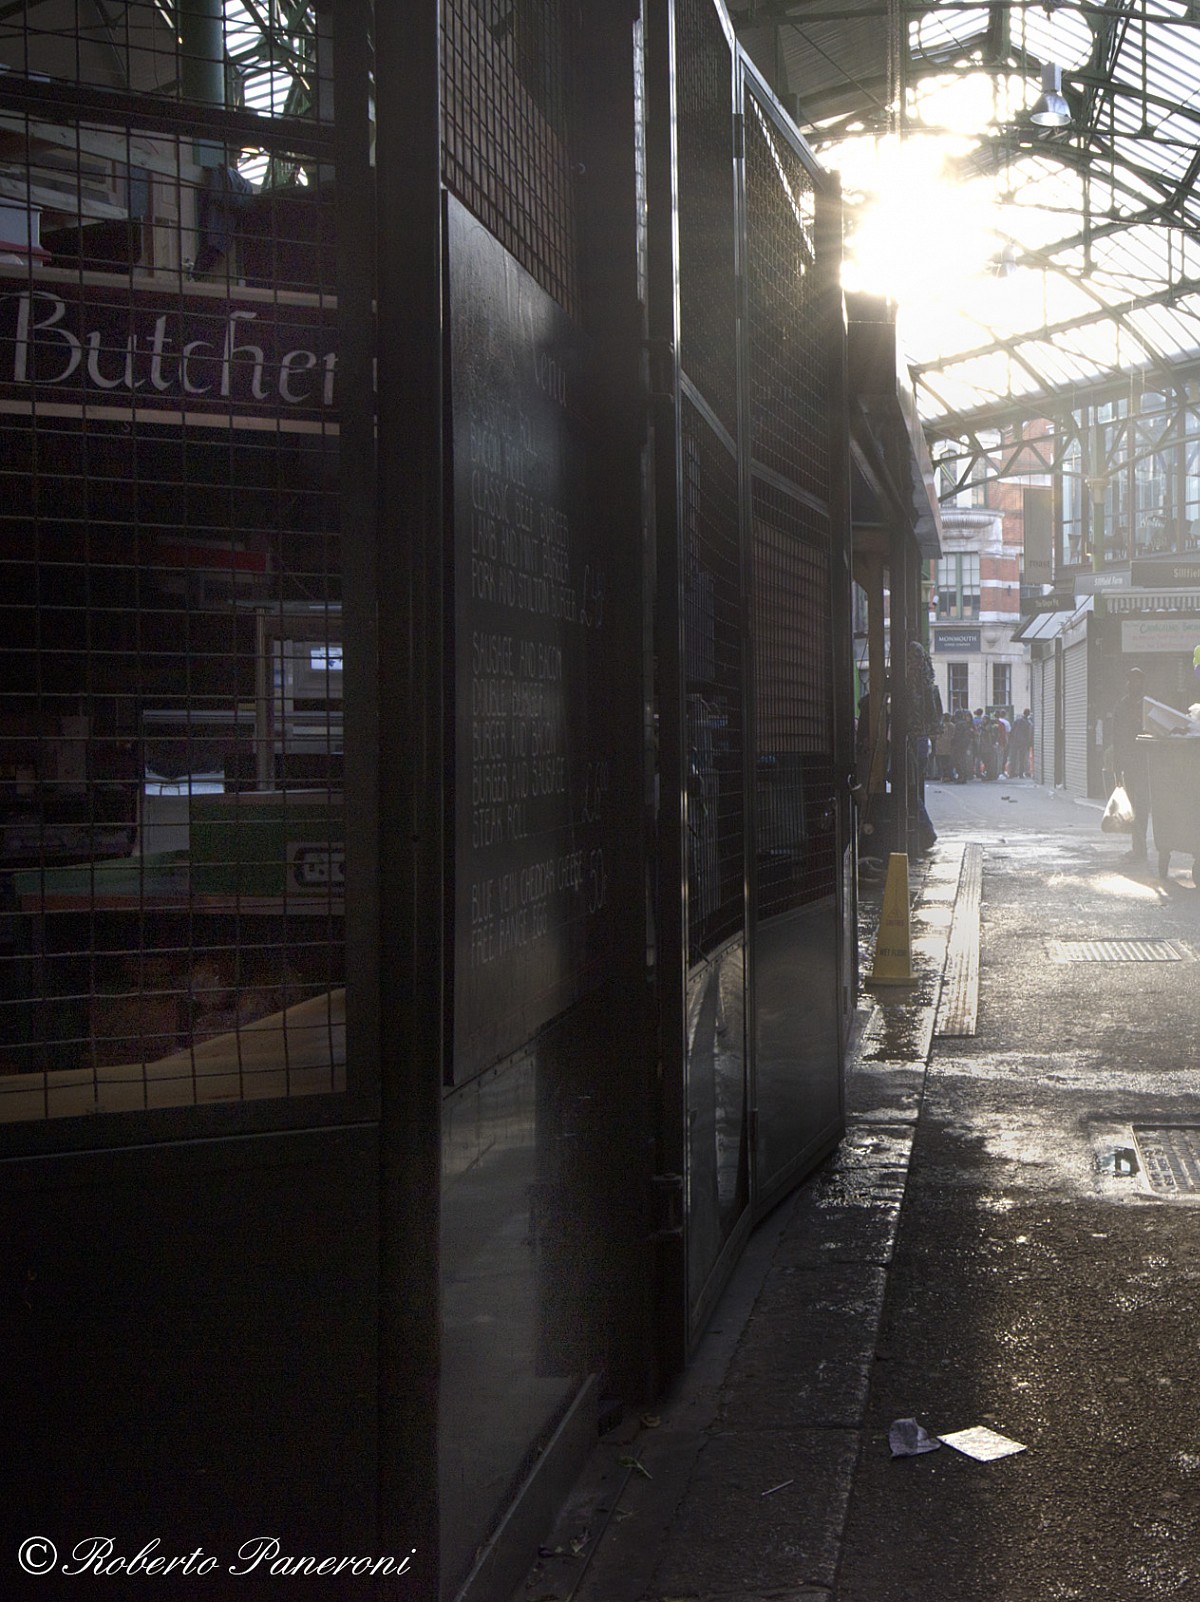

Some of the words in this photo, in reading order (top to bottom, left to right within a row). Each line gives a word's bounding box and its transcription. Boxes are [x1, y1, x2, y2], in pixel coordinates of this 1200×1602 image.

[471, 513, 497, 560] LAMB
[500, 526, 517, 567] AND
[471, 557, 496, 602] PORK
[498, 566, 516, 607] AND
[471, 631, 514, 675] SAUSAGE
[519, 640, 535, 678] AND
[538, 643, 562, 681] BACON
[472, 721, 507, 761] BURGER
[511, 721, 528, 758] AND
[472, 763, 508, 806] BURGER
[512, 761, 529, 799] AND
[472, 809, 503, 849] STEAK
[507, 803, 528, 840] ROLL
[472, 879, 494, 925] BLUE
[498, 872, 517, 913] VEIN
[520, 859, 555, 905] CHEDDAR
[471, 922, 494, 969] FREE
[499, 909, 528, 957] RANGE
